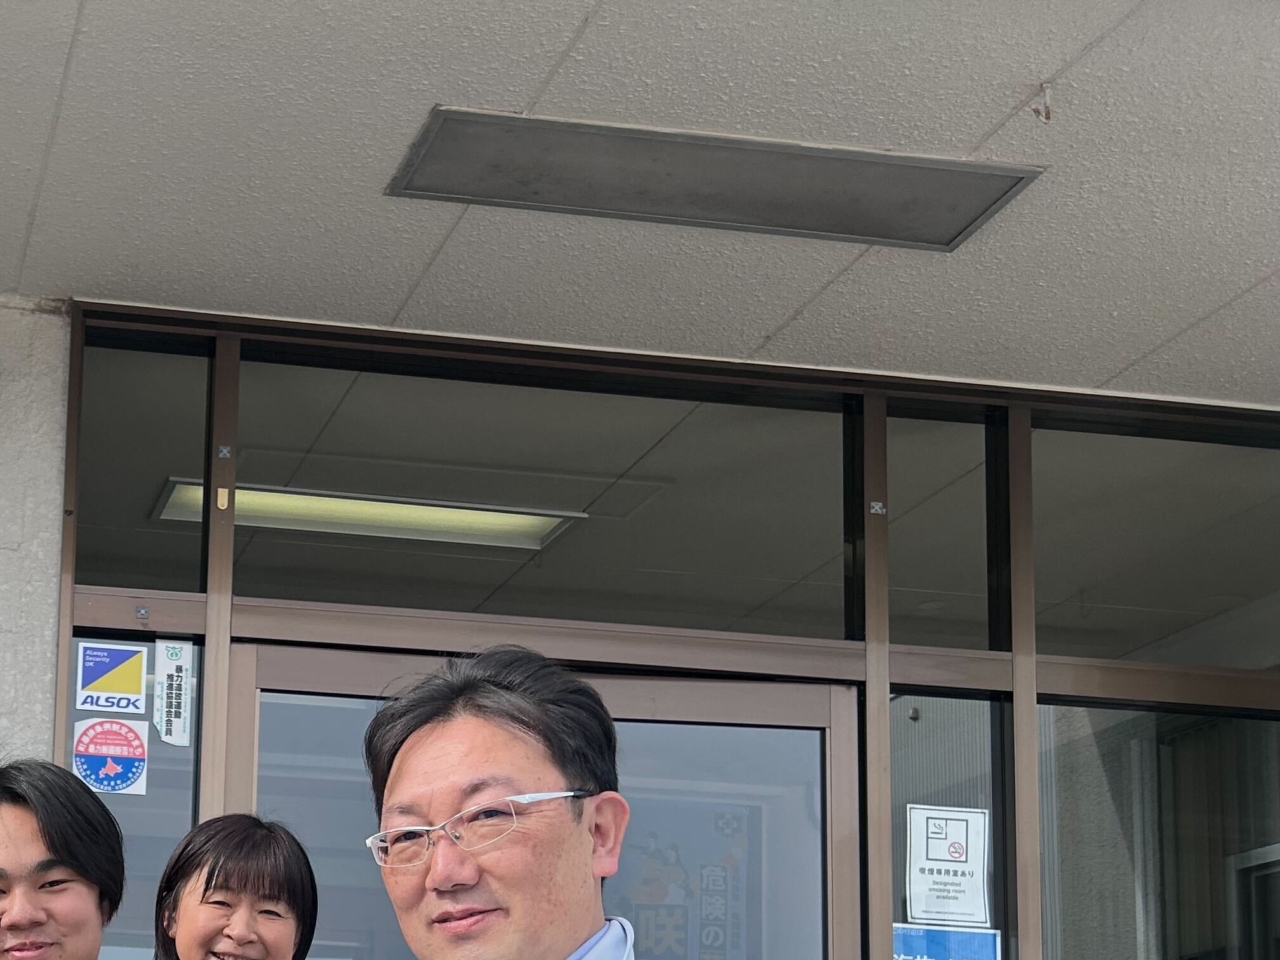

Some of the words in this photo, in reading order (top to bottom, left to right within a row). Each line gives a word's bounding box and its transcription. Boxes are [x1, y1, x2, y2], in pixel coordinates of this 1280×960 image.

[85, 655, 111, 664] Security
[173, 665, 183, 719] 暴力追放運動
[80, 694, 141, 710] ALSOK
[918, 867, 974, 878] 喫煙専用室あり
[932, 880, 962, 888] Designated
